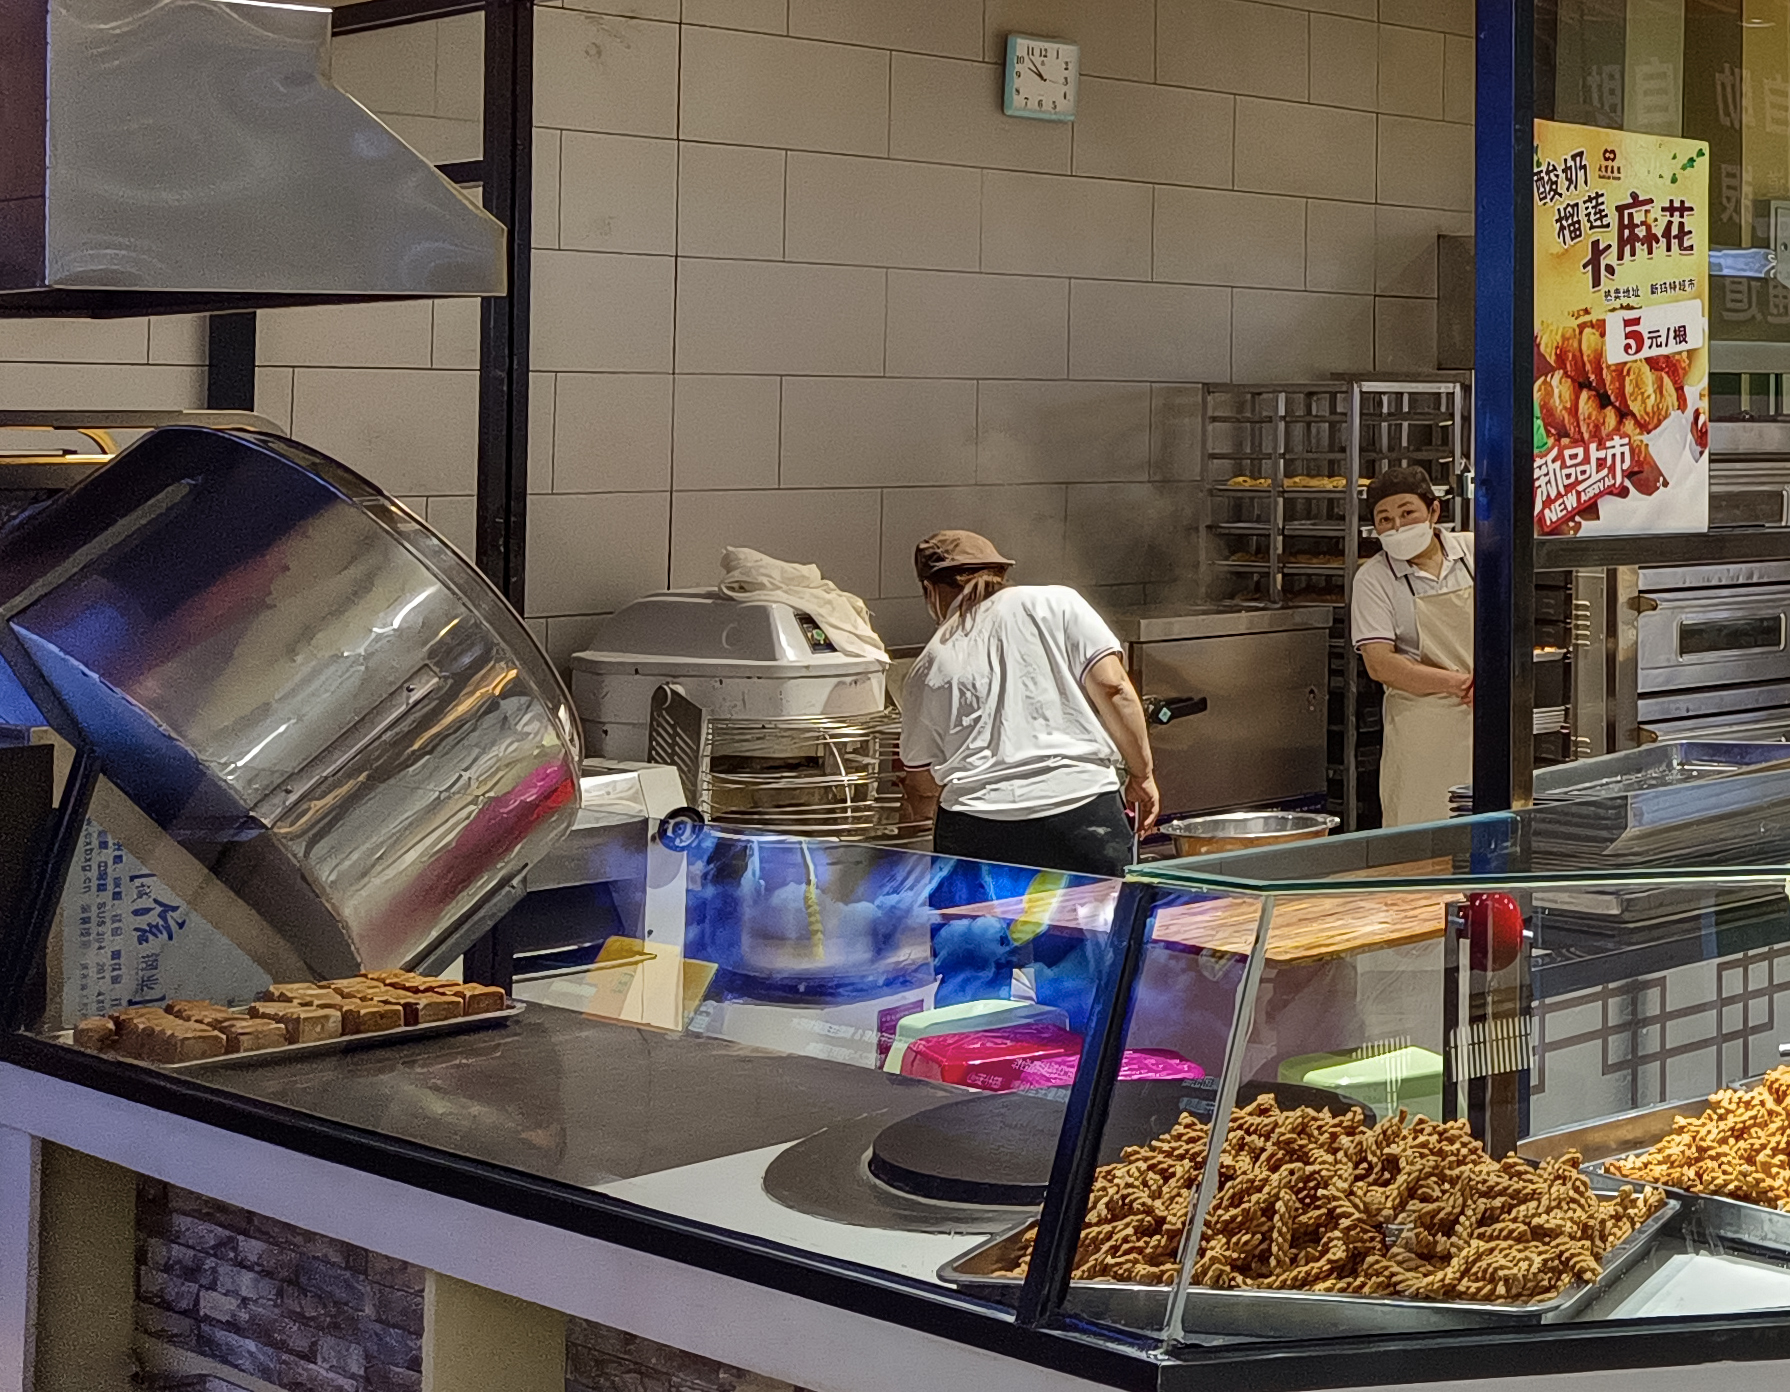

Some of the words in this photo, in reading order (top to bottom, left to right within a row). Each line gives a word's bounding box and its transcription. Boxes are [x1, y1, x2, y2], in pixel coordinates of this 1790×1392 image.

[1534, 150, 1589, 203] 酸奶
[1555, 191, 1611, 246] 榴莲
[1622, 315, 1688, 356] 5元/根
[1534, 435, 1631, 517] 新品上市
[1544, 489, 1577, 526] NEW
[1581, 473, 1615, 504] ARRIVAL
